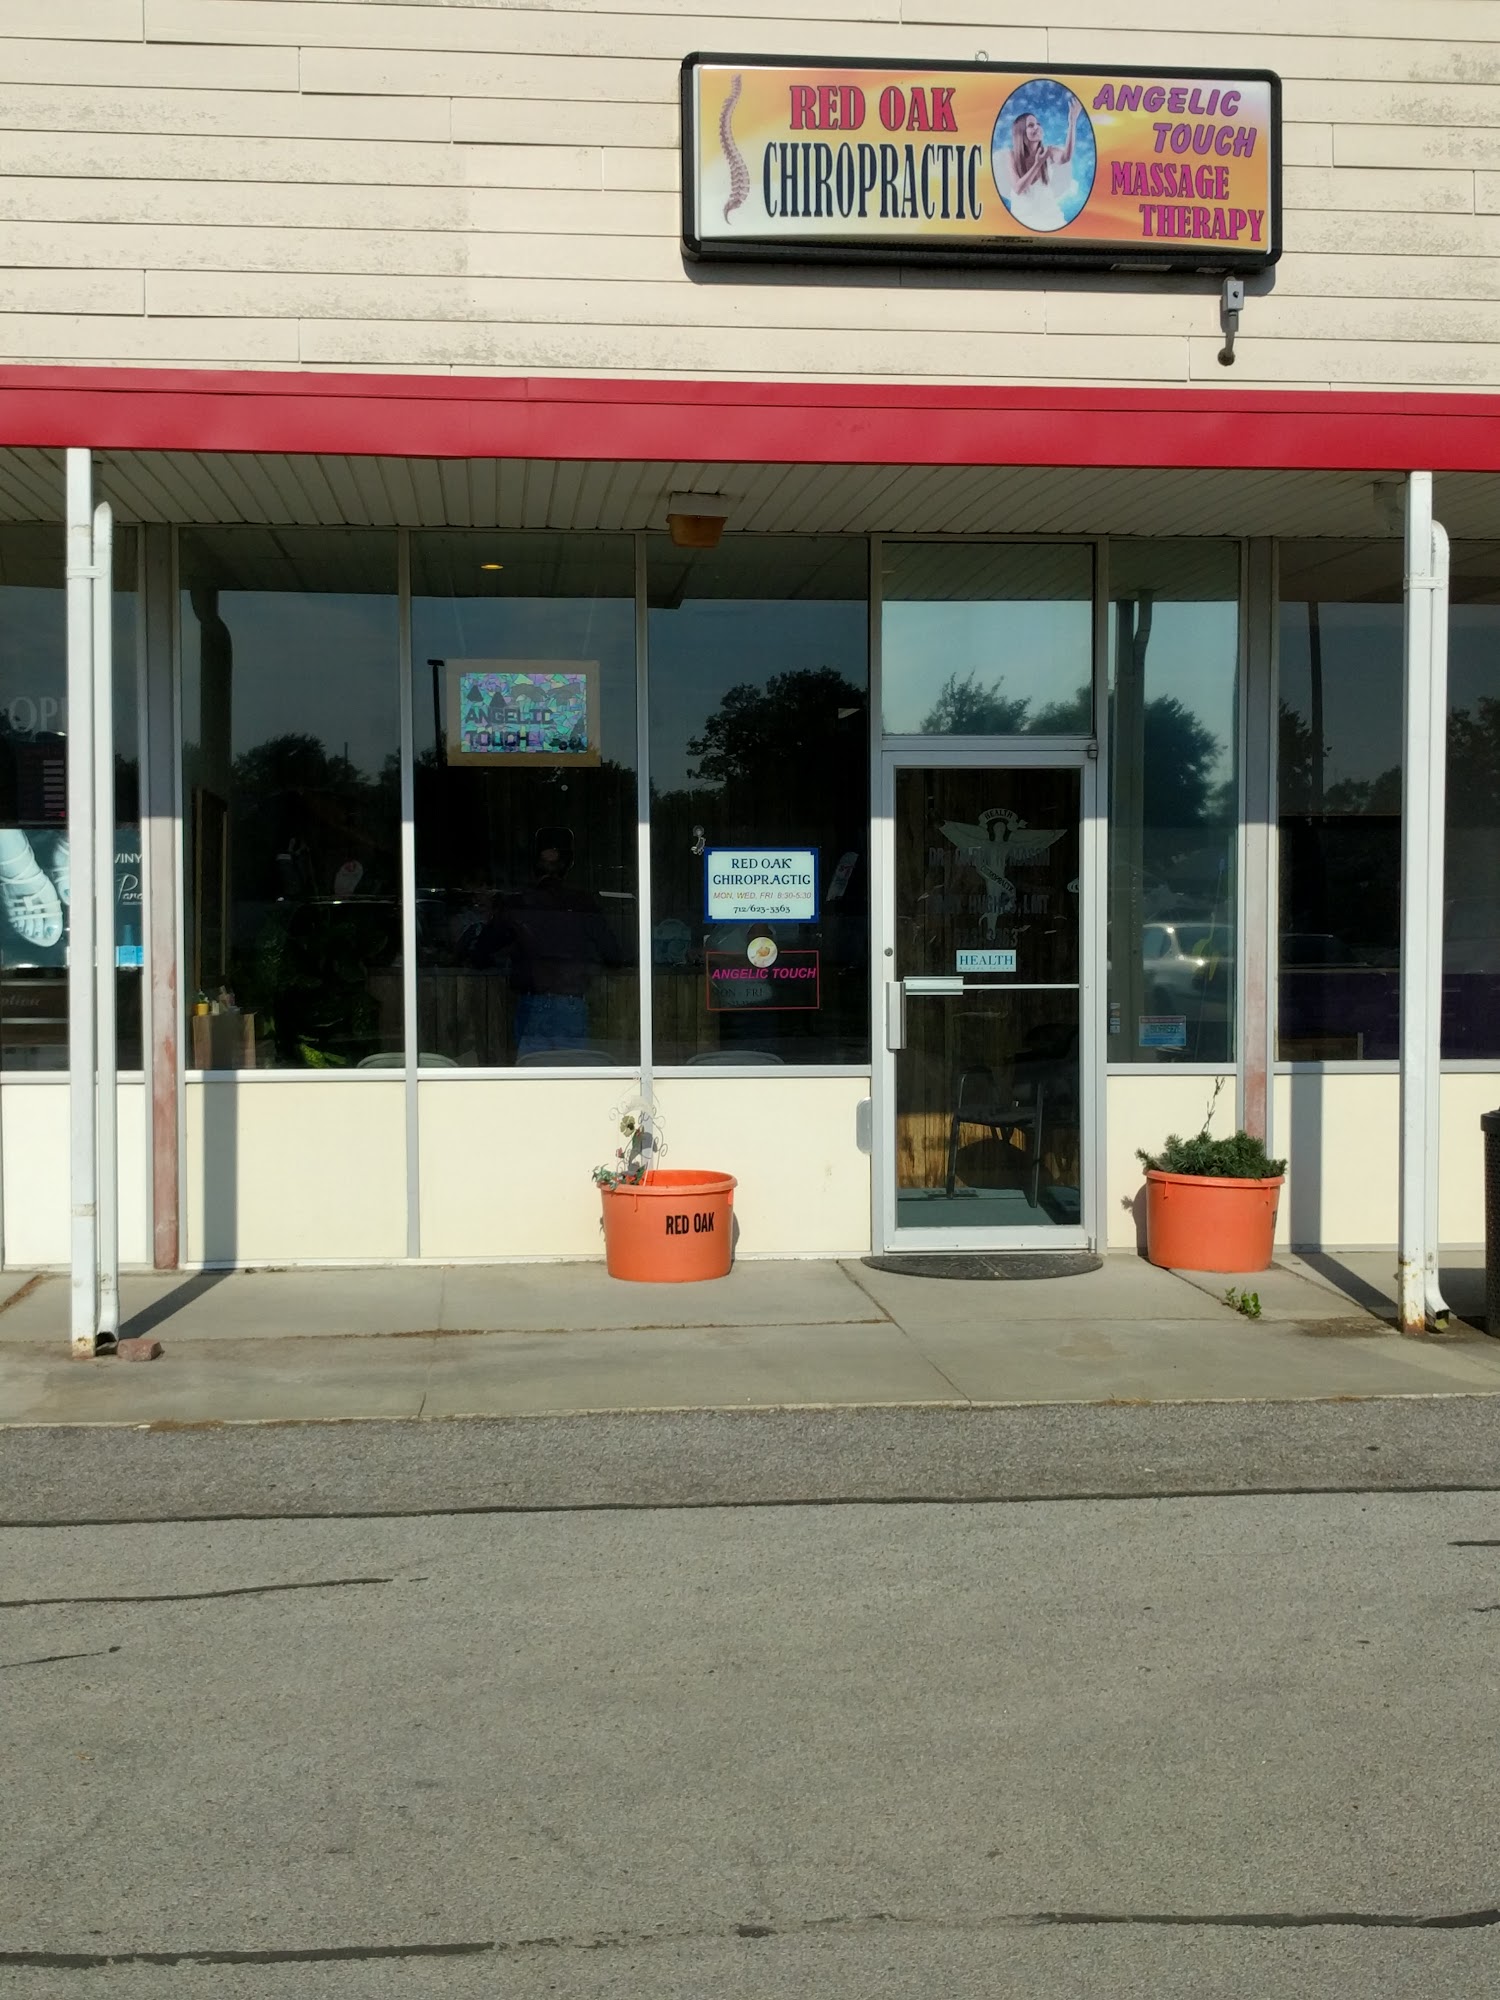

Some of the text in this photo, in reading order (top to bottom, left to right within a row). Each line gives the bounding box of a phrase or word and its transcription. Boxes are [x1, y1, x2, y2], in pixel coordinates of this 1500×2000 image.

[789, 85, 959, 132] RED OAK
[1092, 83, 1242, 117] ANGELIC
[1152, 122, 1258, 158] TOUCH
[763, 141, 983, 221] CHIROPRACTIC
[1111, 161, 1230, 200] MASSAGE
[1139, 204, 1265, 242] THERAPY
[465, 708, 554, 724] ANGELIC
[731, 858, 793, 869] RED OAK
[760, 892, 774, 900] FRI
[733, 904, 791, 914] 712/623-3363
[959, 955, 1013, 965] HEALTH
[711, 968, 817, 979] ANGELIC TOUCH
[665, 1212, 715, 1235] RED OAK
